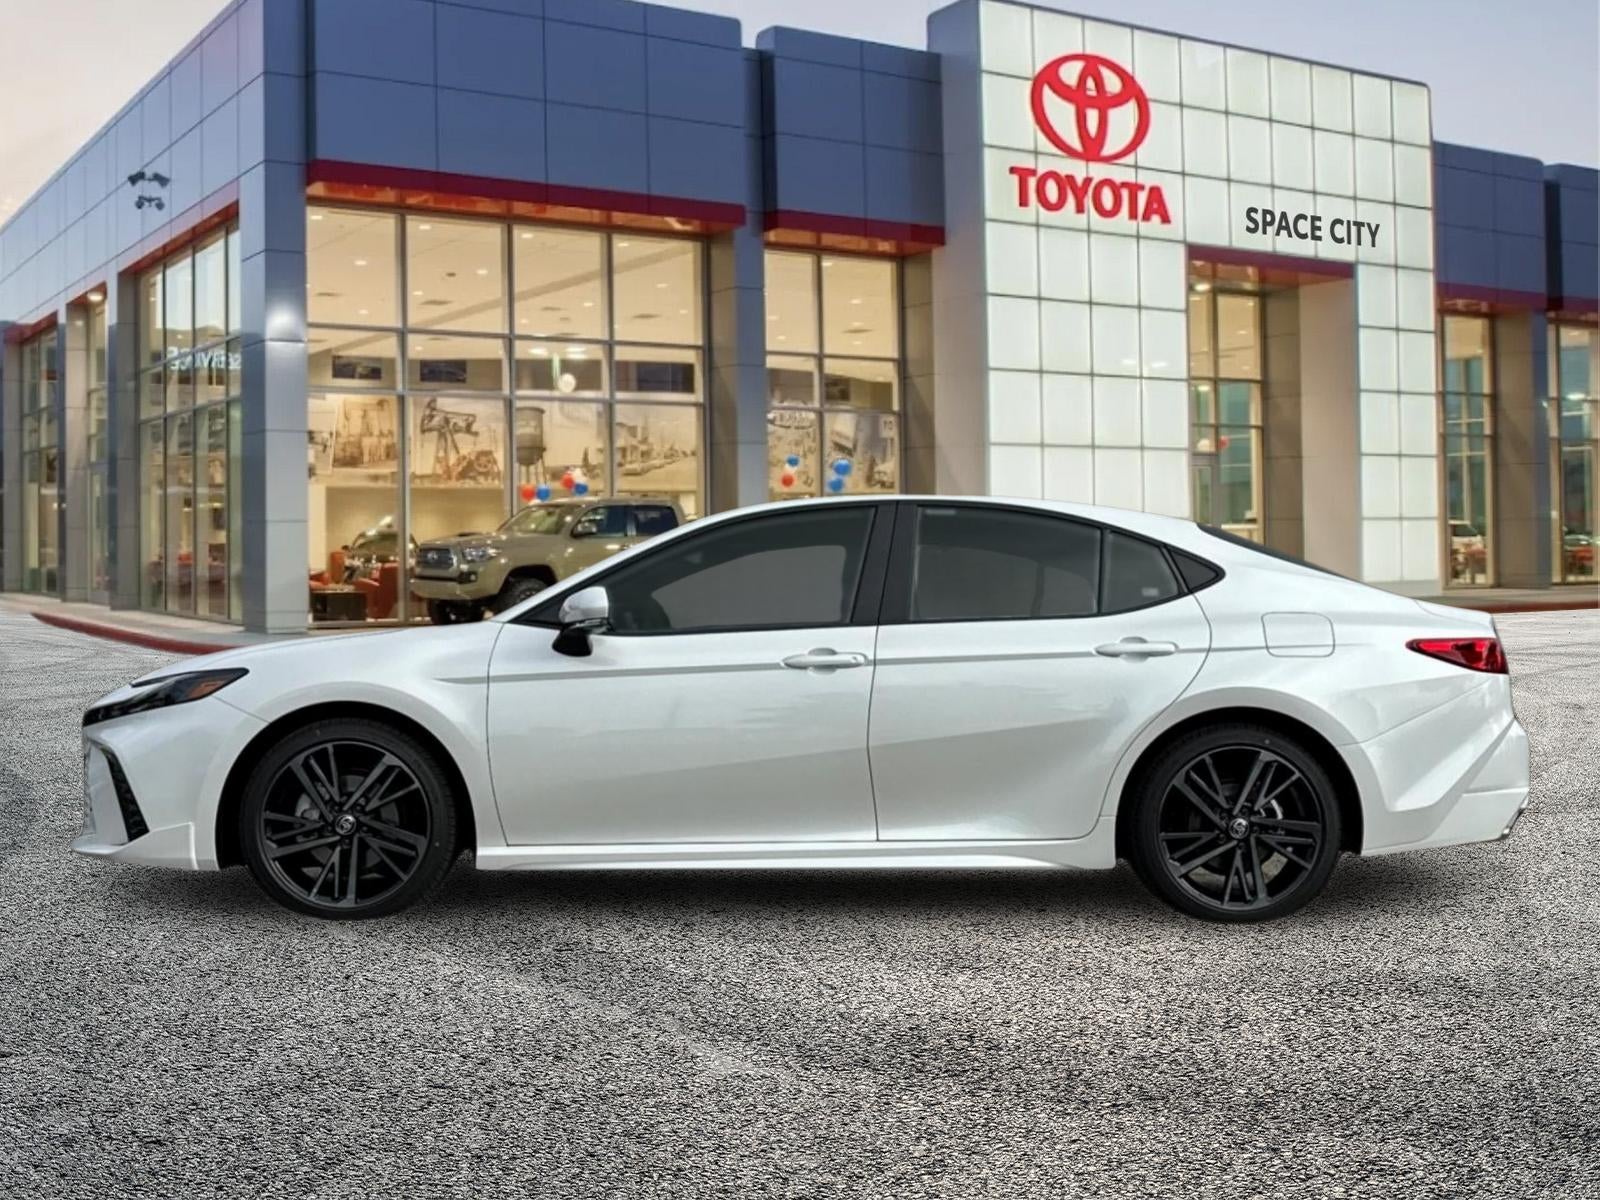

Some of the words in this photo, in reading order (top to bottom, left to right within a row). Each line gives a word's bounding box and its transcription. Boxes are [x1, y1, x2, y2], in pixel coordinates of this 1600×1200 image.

[1009, 166, 1171, 224] TOYOTA
[1245, 206, 1323, 242] SPACE
[1329, 218, 1381, 248] CITY
